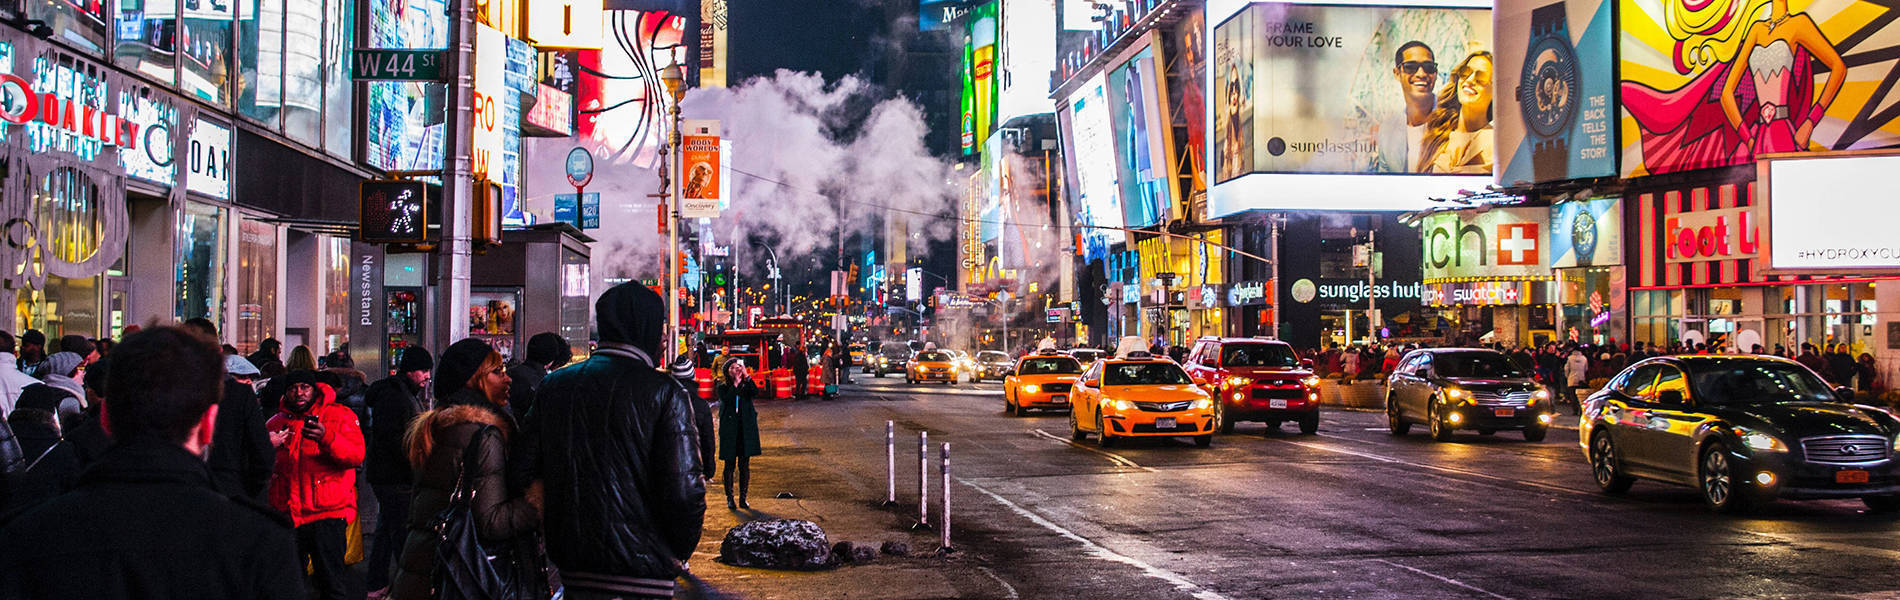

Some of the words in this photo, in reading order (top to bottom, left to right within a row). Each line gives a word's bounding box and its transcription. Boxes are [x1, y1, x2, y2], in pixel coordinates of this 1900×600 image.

[1265, 22, 1313, 34] FRAME
[1265, 36, 1304, 48] YOUR
[1307, 37, 1343, 48] LOVE
[359, 53, 381, 77] W
[385, 53, 416, 77] 44
[422, 54, 434, 67] St
[1589, 95, 1606, 107] THE
[43, 92, 140, 150] OAKLEY
[1583, 108, 1606, 121] BACK
[1581, 121, 1607, 133] TELLS
[1590, 134, 1607, 145] THE
[1290, 138, 1352, 157] sunglass
[1354, 138, 1378, 154] hut
[1580, 147, 1607, 160] STORY
[1666, 215, 1732, 259] Foot
[1738, 211, 1759, 254] L
[361, 255, 374, 326] Newsstand
[1318, 280, 1390, 303] sunglass
[1392, 280, 1421, 298] hut
[1453, 286, 1507, 301] swatch
